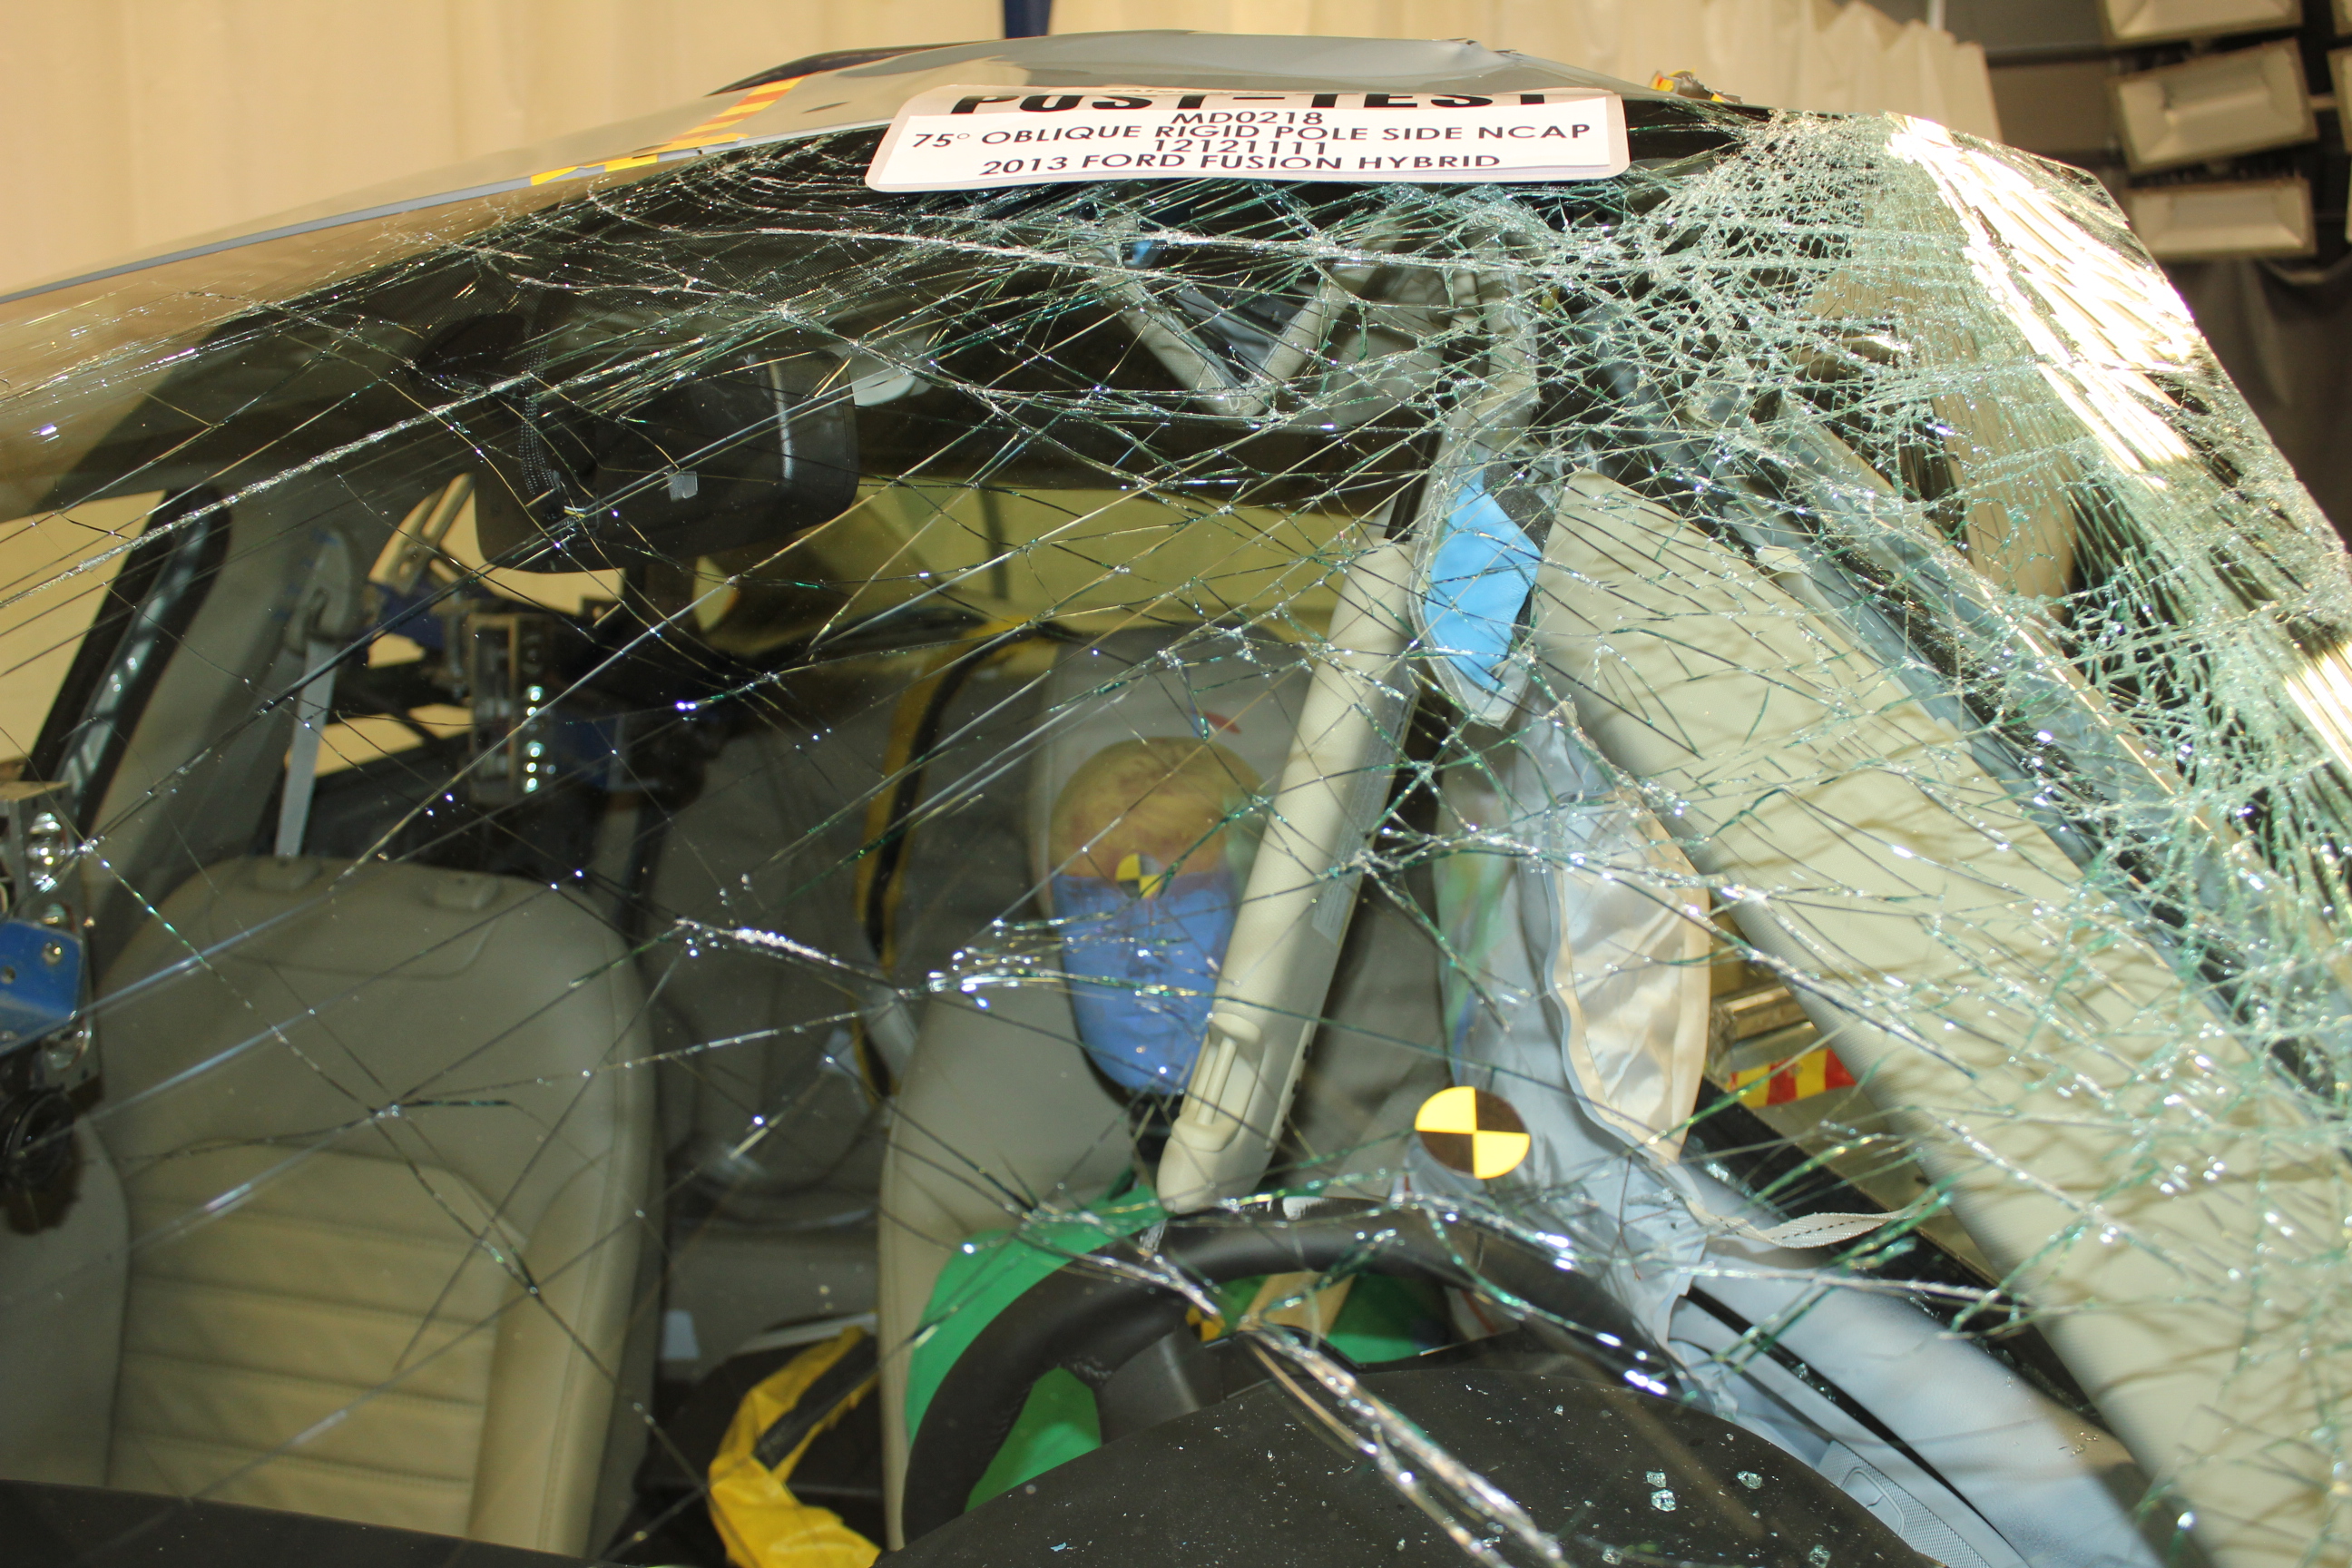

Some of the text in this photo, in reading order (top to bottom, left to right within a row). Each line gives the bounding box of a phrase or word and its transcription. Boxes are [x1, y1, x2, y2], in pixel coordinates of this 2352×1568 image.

[1171, 111, 1324, 126] MD0218
[982, 125, 1142, 145] OBLIQUE
[1155, 124, 1260, 139] RIGID
[1275, 127, 1368, 141] POLE
[1382, 127, 1463, 141] SIDE
[1478, 123, 1591, 140] NCAP
[1155, 140, 1327, 155] 1212111
[979, 153, 1501, 176] 2013 FORD FUSION HYBRID
